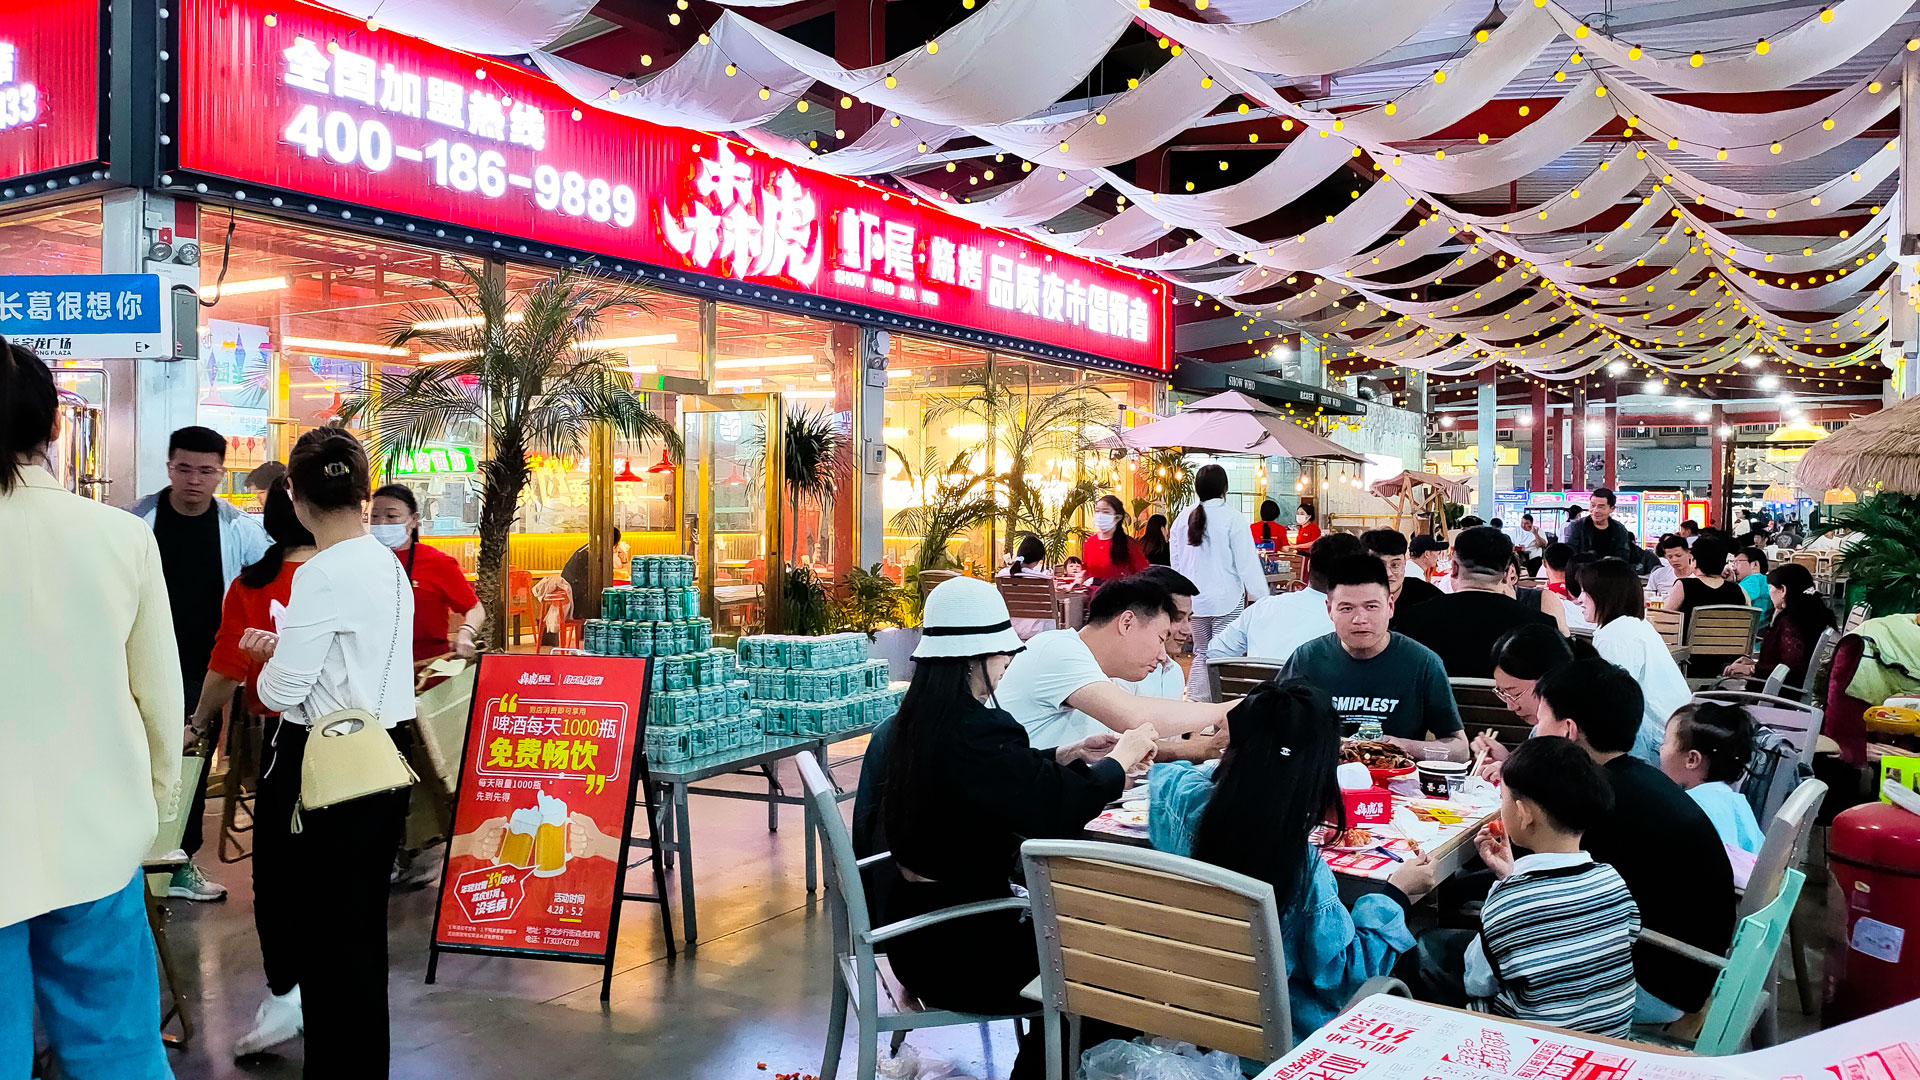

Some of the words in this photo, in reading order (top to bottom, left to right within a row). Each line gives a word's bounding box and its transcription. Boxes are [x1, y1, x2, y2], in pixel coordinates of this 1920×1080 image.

[283, 39, 546, 151] 全国加盟热线
[285, 104, 636, 227] 400-186-9889
[834, 269, 866, 289] SHOW
[872, 277, 895, 296] WHO
[0, 290, 143, 322] 长葛很想你
[135, 341, 142, 353] E
[492, 714, 619, 739] 啤酒每天1000瓶
[486, 736, 599, 771] 免费畅饮
[478, 778, 542, 790] 每天限量1000瓶
[476, 791, 511, 803] 先到先得
[546, 904, 564, 915] 4.28
[571, 906, 584, 917] 5.2
[553, 892, 586, 905] 活动时间
